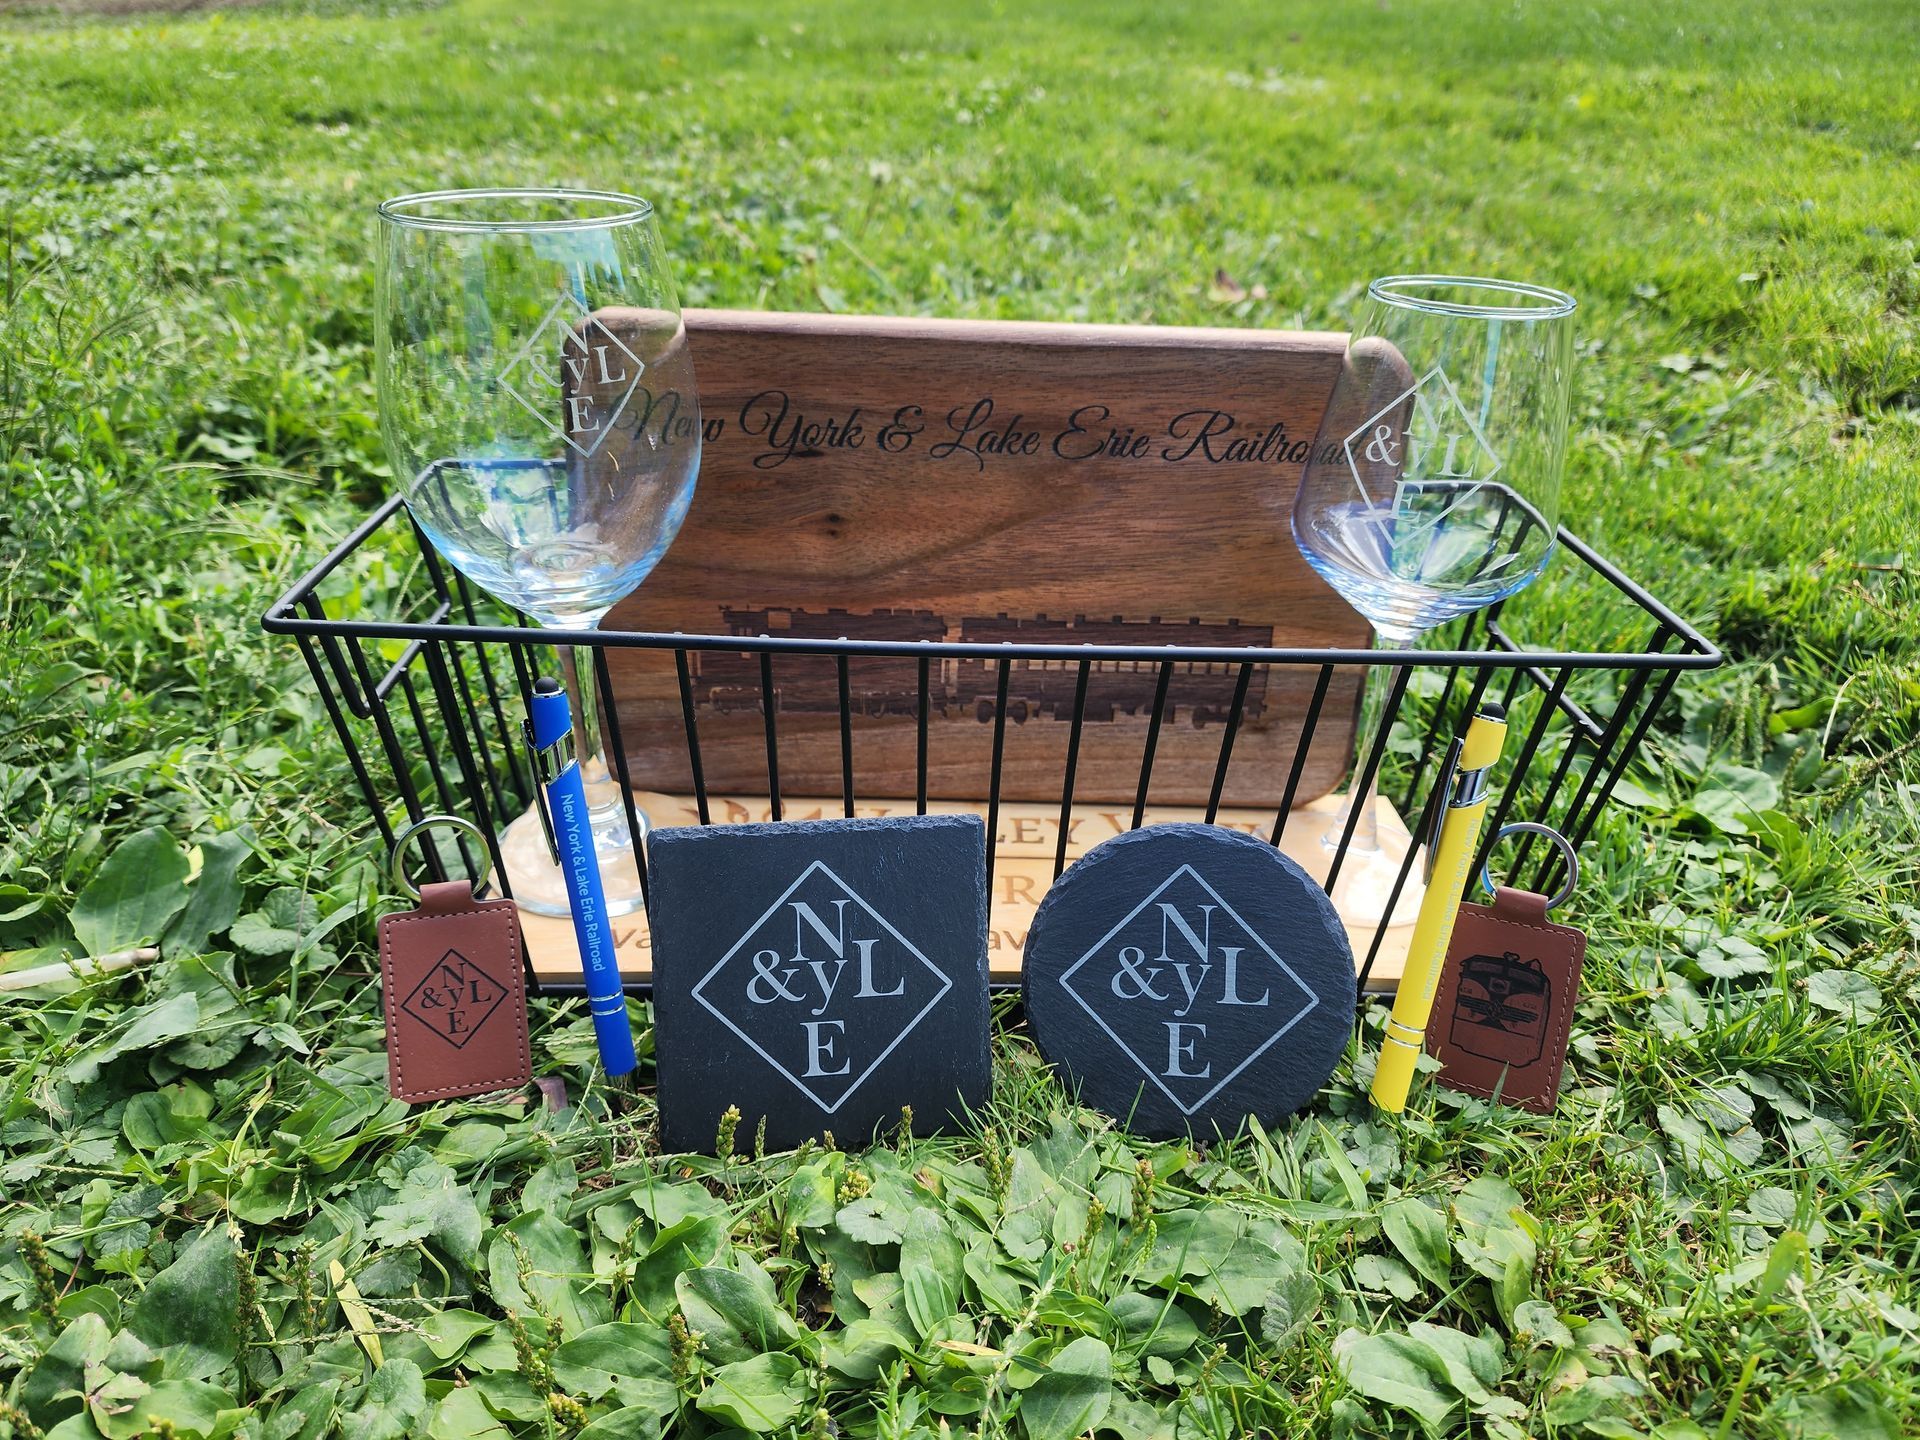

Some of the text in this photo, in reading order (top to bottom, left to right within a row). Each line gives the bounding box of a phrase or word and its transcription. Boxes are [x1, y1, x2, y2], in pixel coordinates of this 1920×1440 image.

[739, 391, 865, 469] York
[877, 405, 924, 452] &
[929, 398, 1040, 471] Lake
[1052, 405, 1150, 460] Erie
[1465, 818, 1480, 848] New
[561, 793, 606, 972] New York & Lake Erie Railroad
